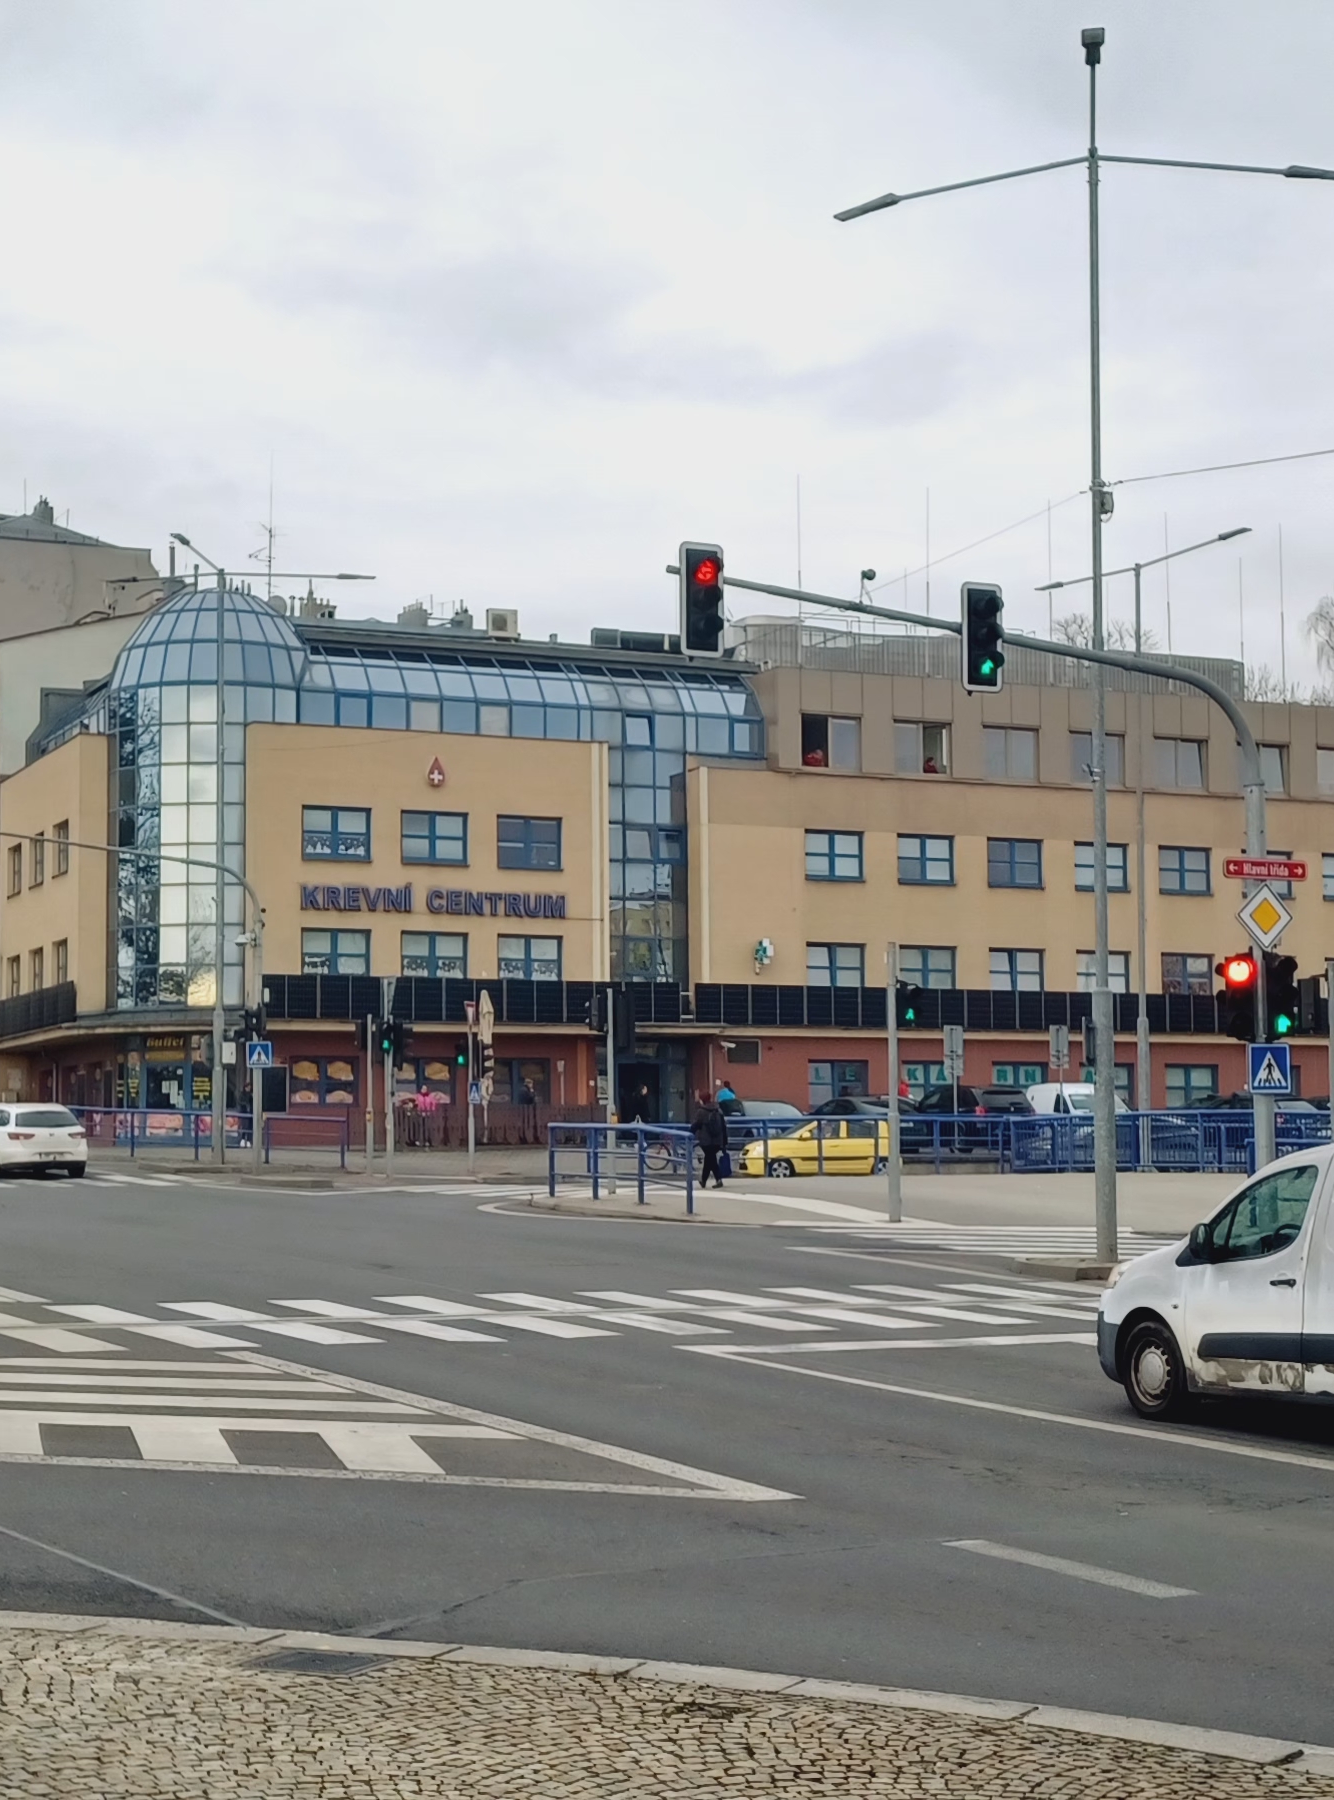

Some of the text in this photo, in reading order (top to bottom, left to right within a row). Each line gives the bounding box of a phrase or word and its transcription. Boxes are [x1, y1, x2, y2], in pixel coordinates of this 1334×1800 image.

[1242, 862, 1289, 877] Hlavní třída
[300, 882, 566, 919] KREVNÍ CENTRUM
